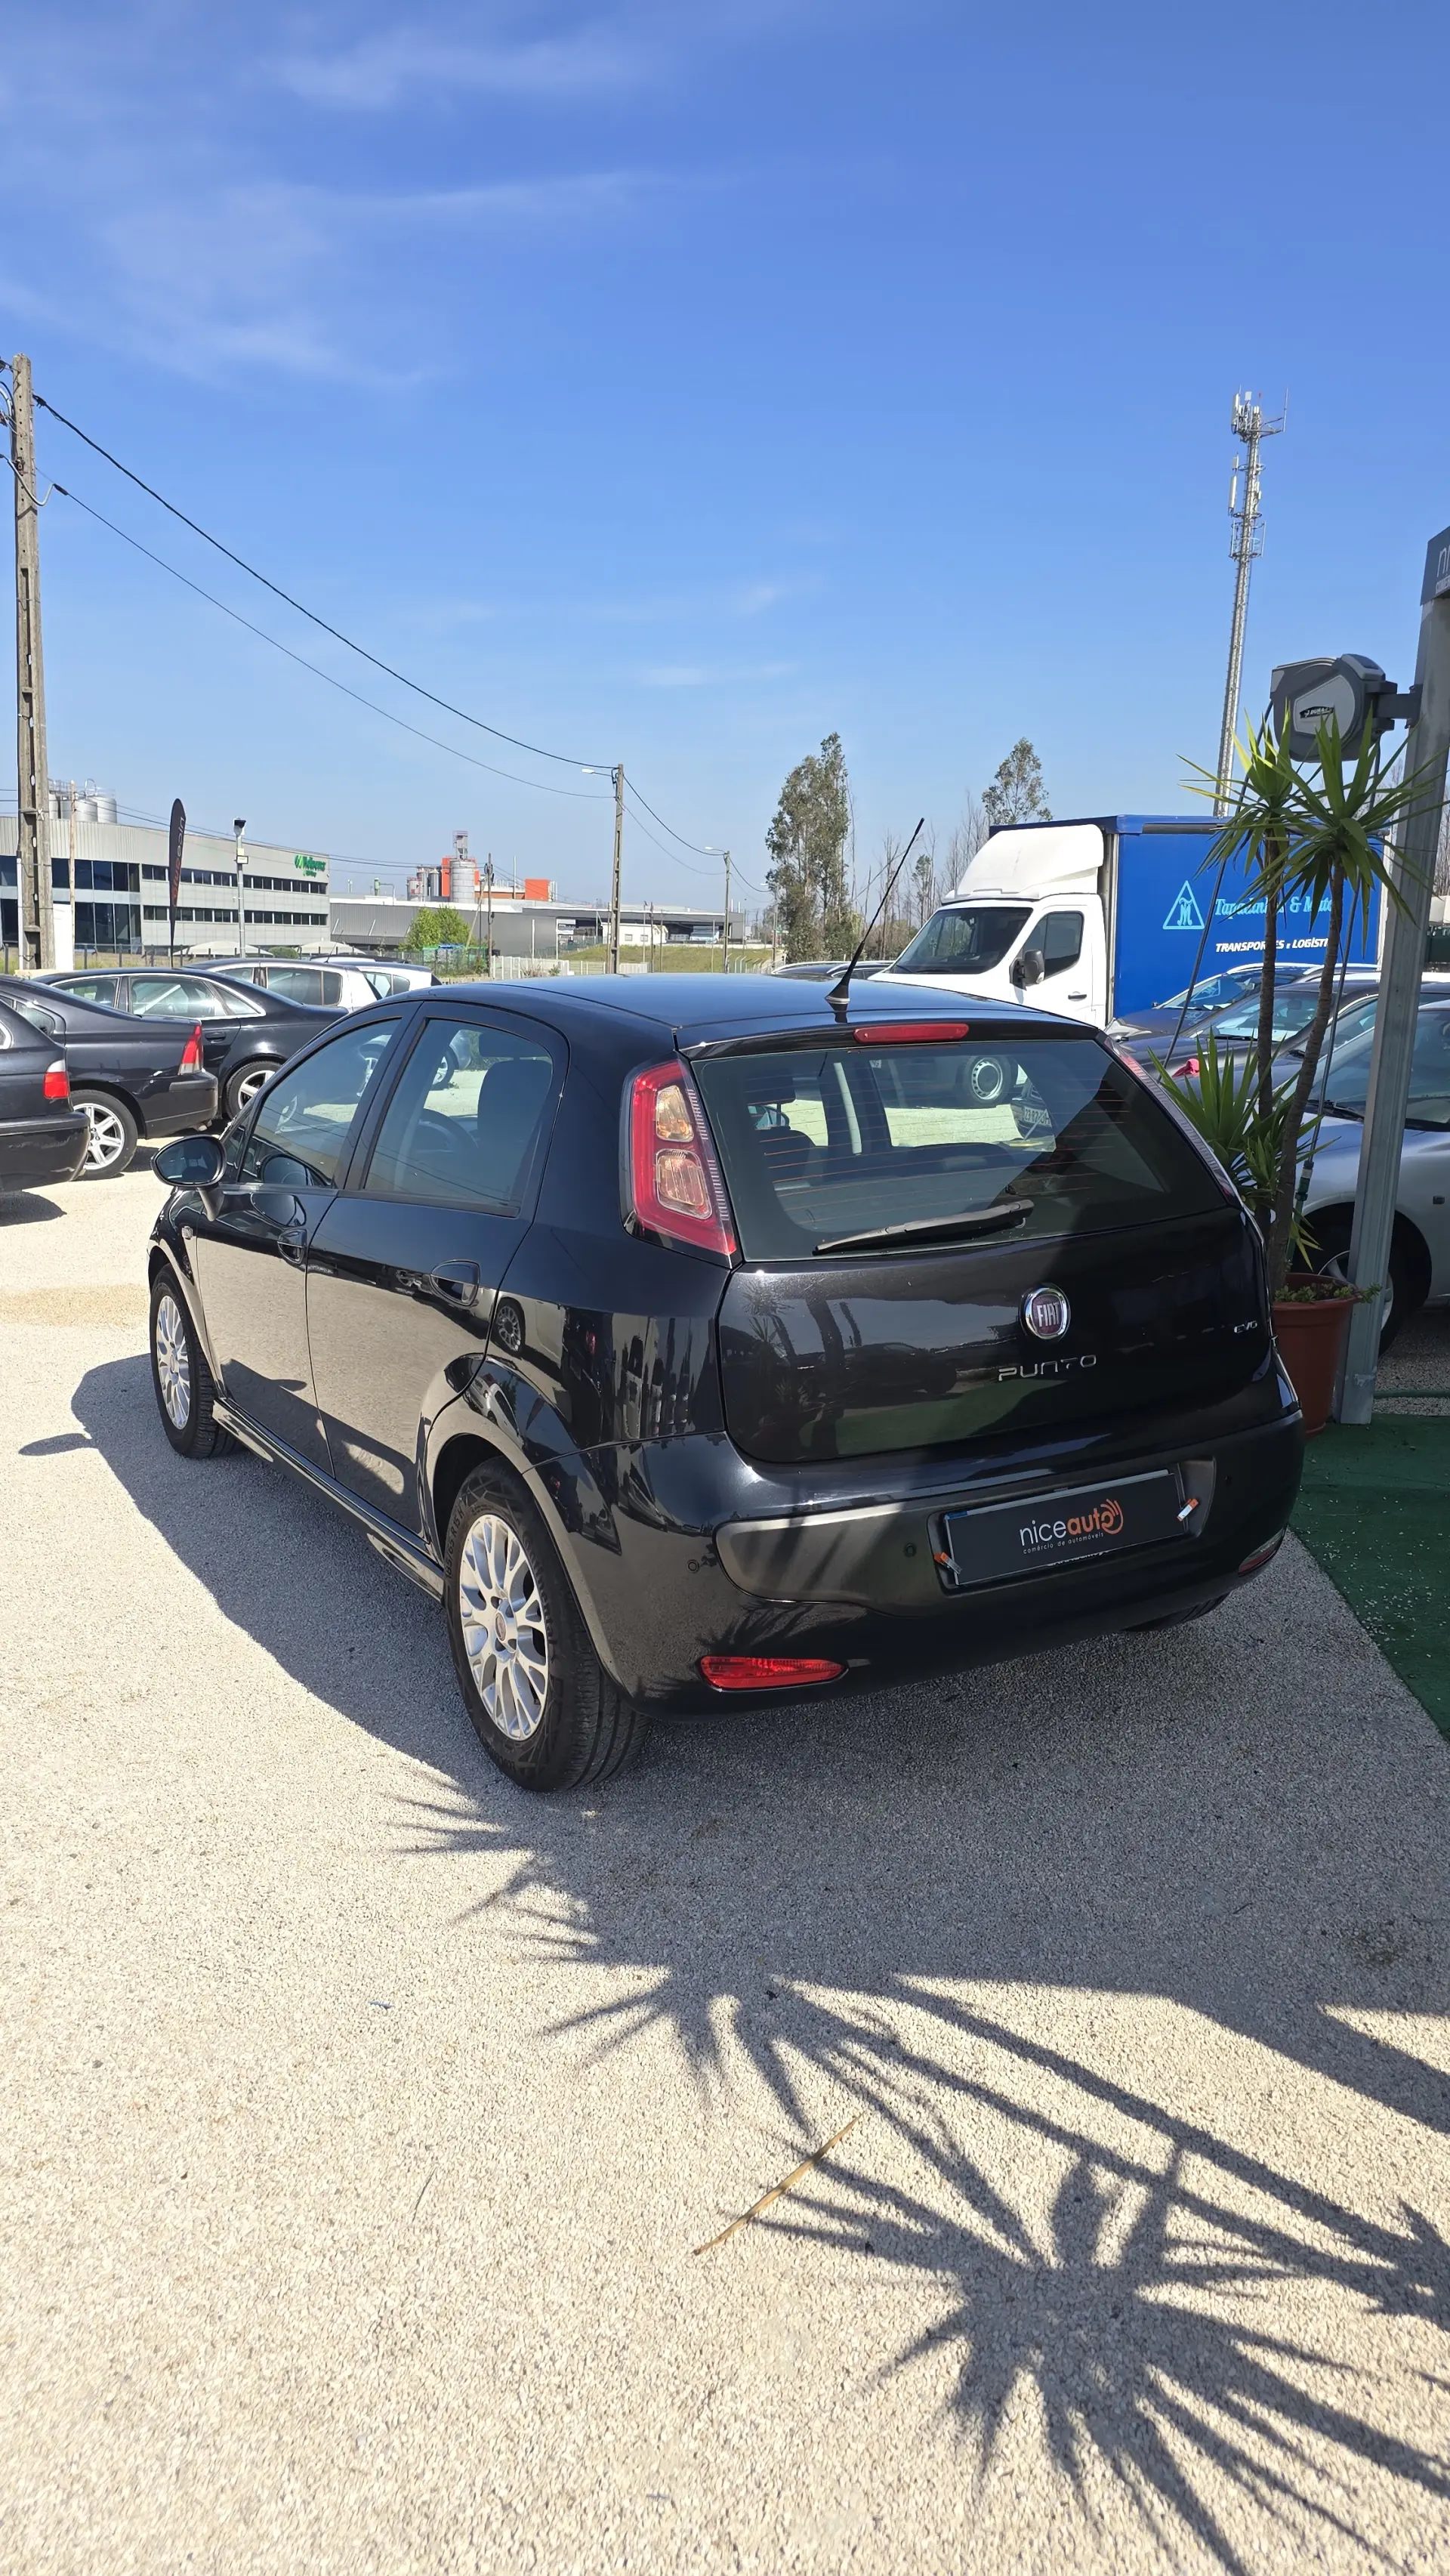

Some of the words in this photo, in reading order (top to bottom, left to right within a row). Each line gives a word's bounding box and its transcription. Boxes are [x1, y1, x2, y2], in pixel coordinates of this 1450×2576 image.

[1289, 896, 1301, 913] &
[1215, 940, 1285, 953] TRANSPORES
[1036, 1302, 1060, 1327] FIAT
[998, 1354, 1097, 1382] PUNTO
[1020, 1499, 1124, 1546] niceauto
[1023, 1543, 1054, 1555] comércio
[1057, 1539, 1066, 1547] de
[1067, 1531, 1105, 1545] automóveis
